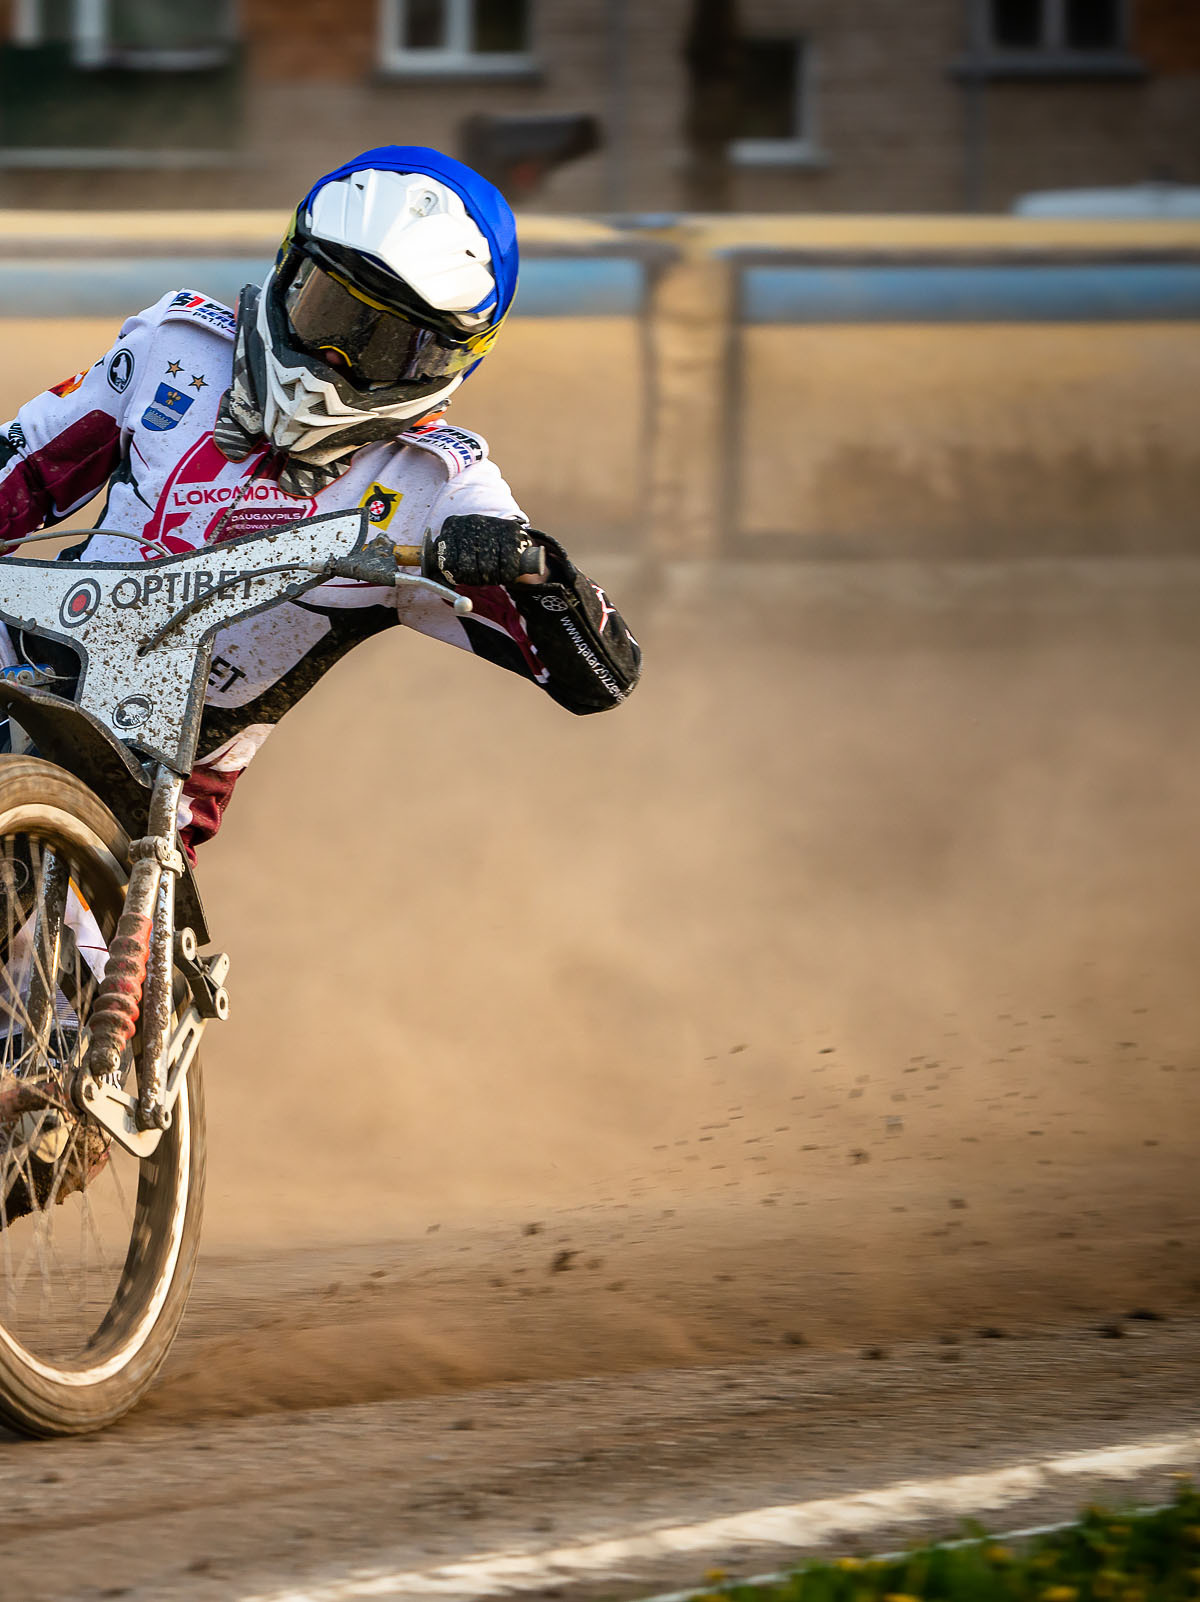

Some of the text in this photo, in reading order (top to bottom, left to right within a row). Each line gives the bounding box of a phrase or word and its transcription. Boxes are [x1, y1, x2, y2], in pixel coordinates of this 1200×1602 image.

[174, 485, 299, 507] LOKOMOT
[231, 512, 301, 522] DAUGAVPILS
[111, 570, 256, 609] OPTIBET
